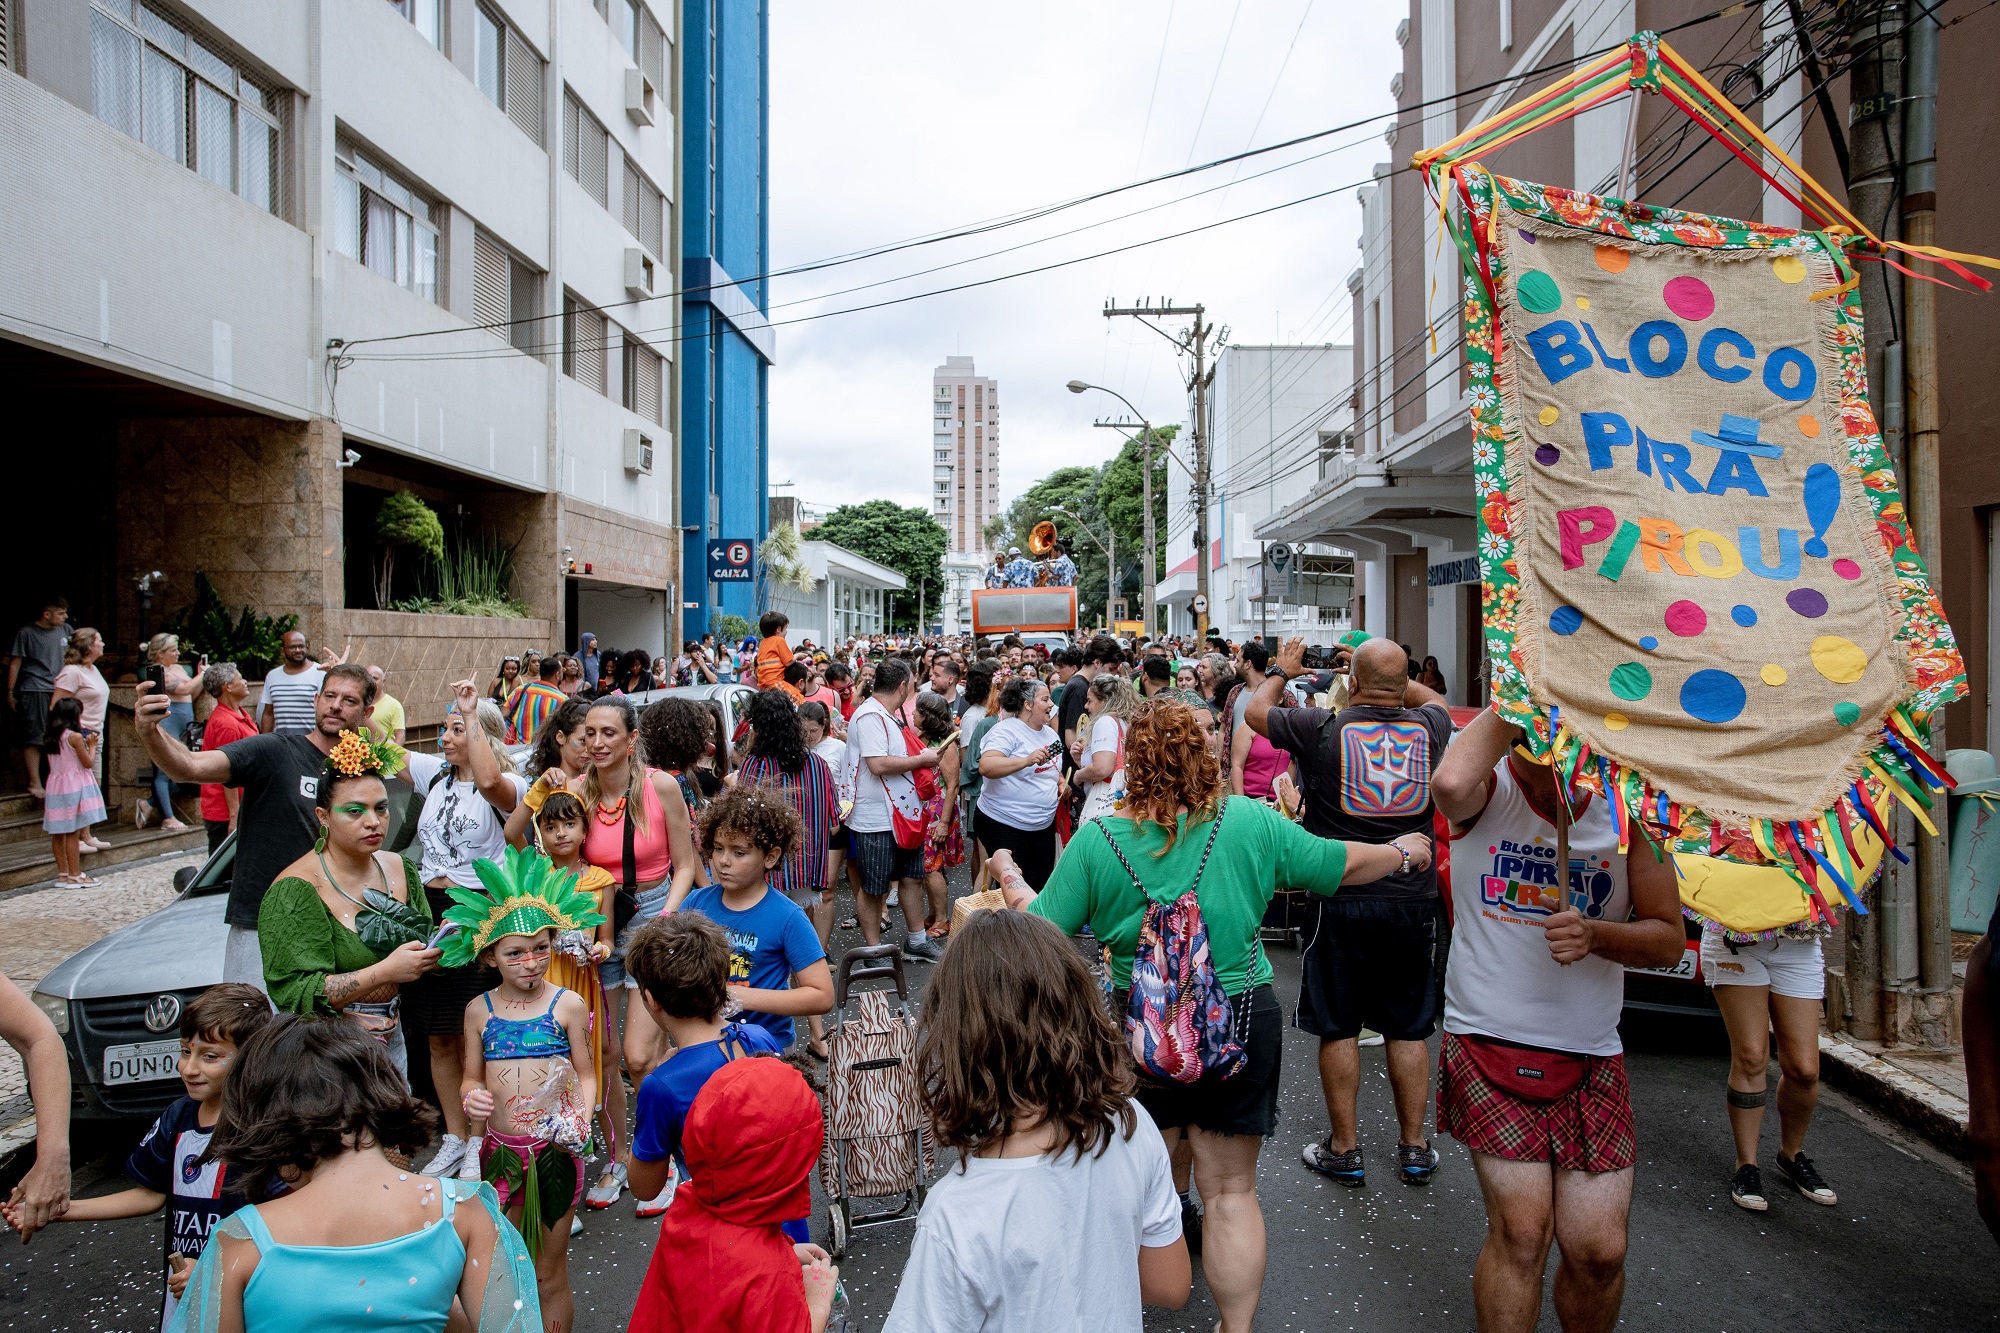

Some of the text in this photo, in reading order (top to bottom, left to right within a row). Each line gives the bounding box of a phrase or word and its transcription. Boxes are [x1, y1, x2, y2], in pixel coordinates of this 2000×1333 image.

[1853, 96, 1887, 120] 281
[1525, 319, 1818, 401] BLOCO
[734, 547, 743, 561] E
[1272, 546, 1288, 564] P
[714, 568, 749, 578] CAIXA
[1428, 560, 1462, 587] SANTAS
[1463, 555, 1480, 581] MIS
[1500, 840, 1556, 859] BLOCO
[1500, 915, 1522, 925] num
[1523, 918, 1545, 928] vam
[133, 1044, 181, 1057] SP-PIRACICA
